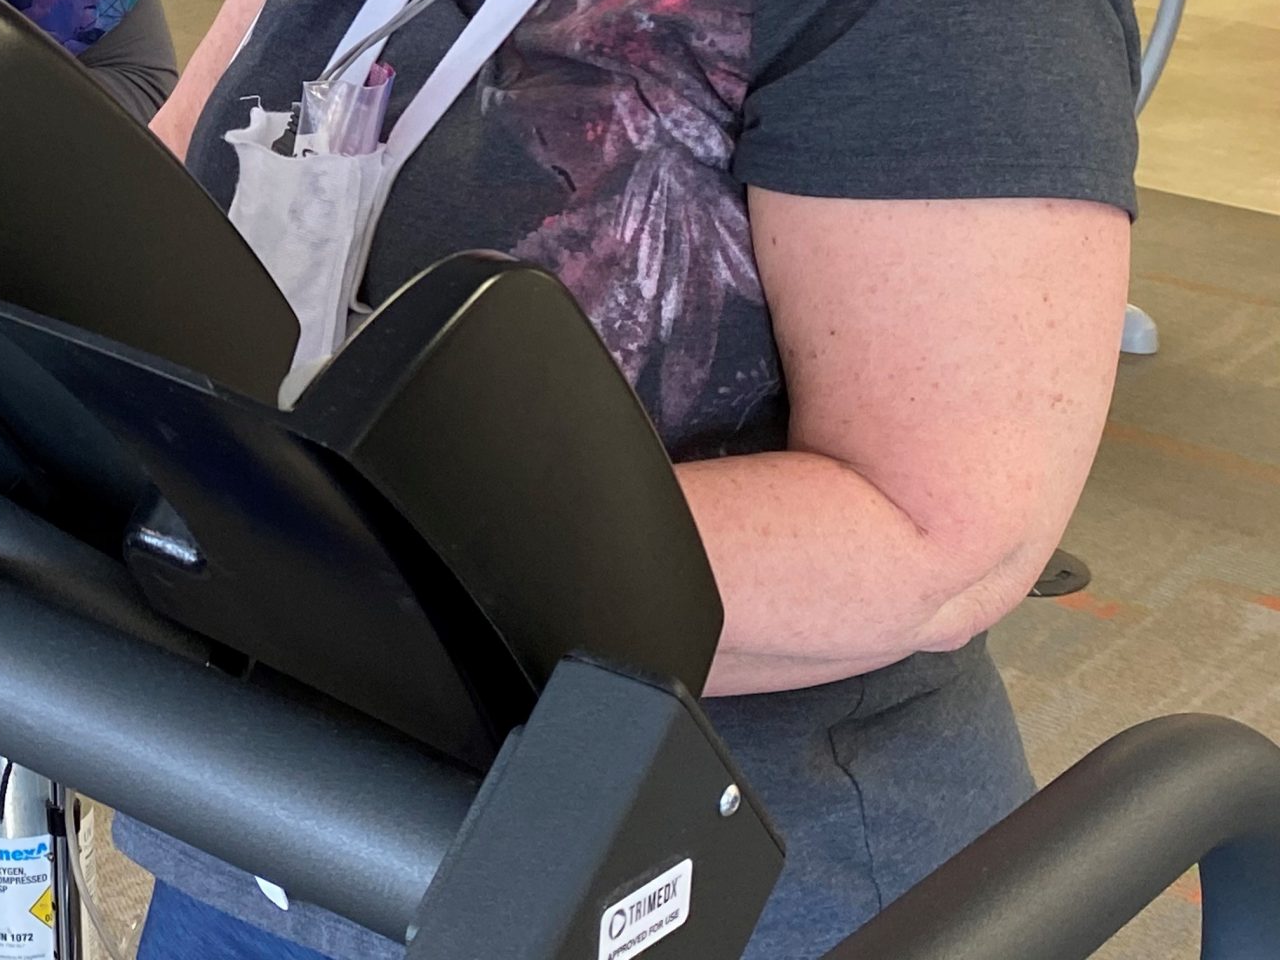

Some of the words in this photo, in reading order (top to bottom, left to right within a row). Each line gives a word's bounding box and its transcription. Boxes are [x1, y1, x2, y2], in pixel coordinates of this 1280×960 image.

[628, 878, 679, 926] TRIMEDX
[10, 933, 34, 942] 1072
[607, 930, 648, 960] APPROVED
[648, 919, 664, 936] FOR
[664, 908, 680, 925] USE
